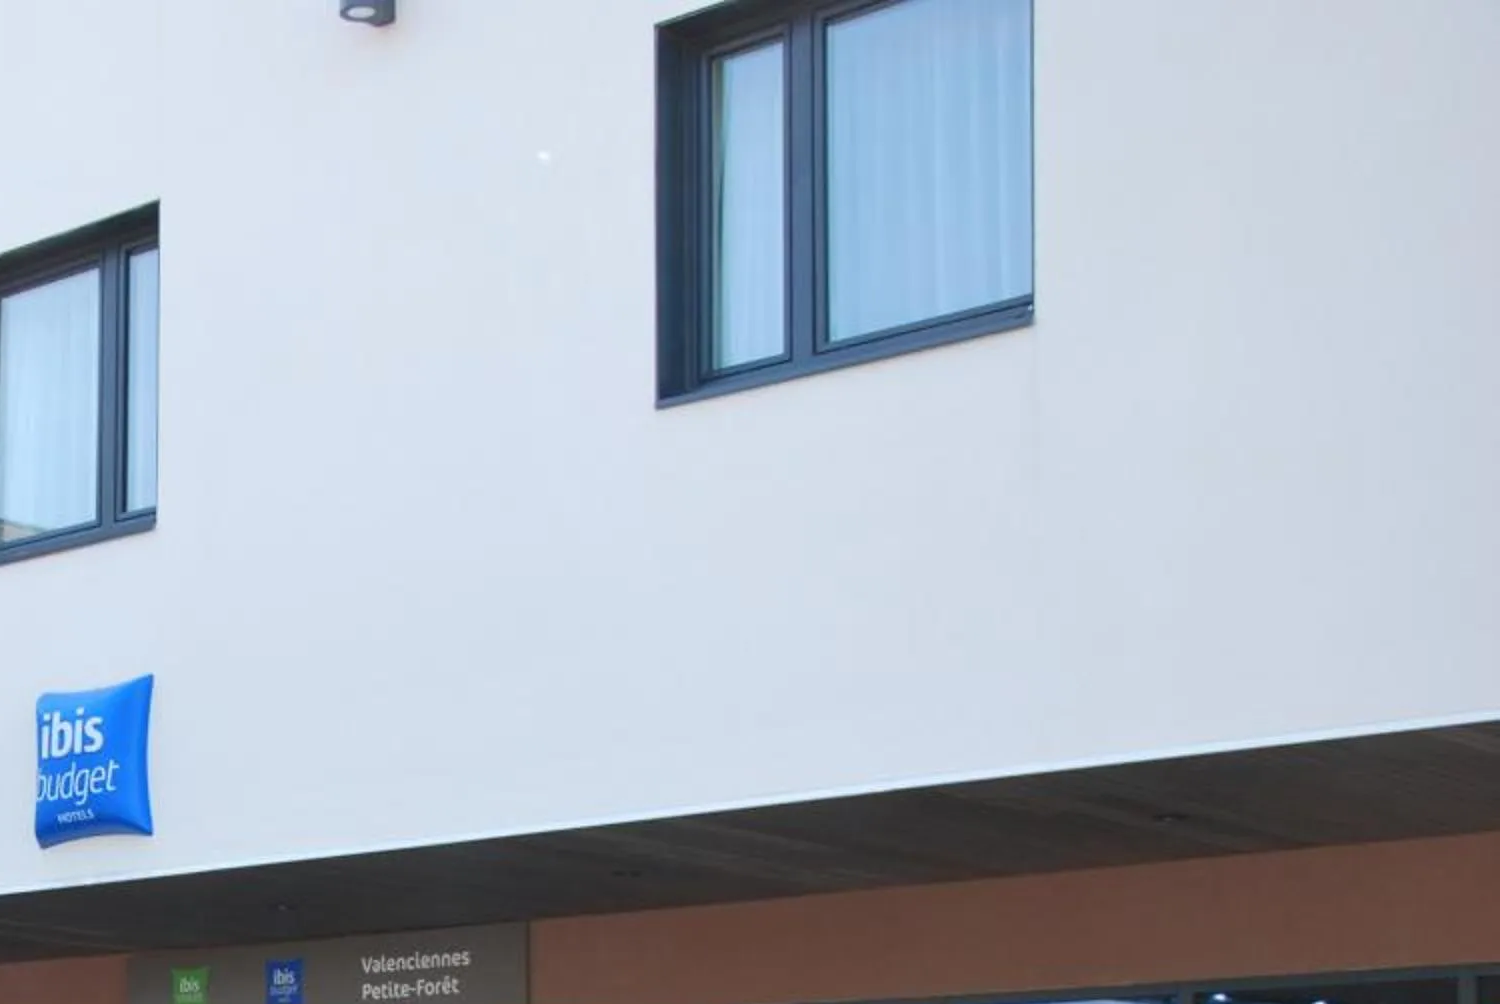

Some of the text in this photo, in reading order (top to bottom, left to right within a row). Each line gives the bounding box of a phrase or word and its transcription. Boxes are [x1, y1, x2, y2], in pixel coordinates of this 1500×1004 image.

[41, 707, 103, 759] ibis
[361, 951, 470, 973] Valenciennes
[180, 976, 200, 993] ibis
[362, 975, 460, 999] Petite-Forêt
